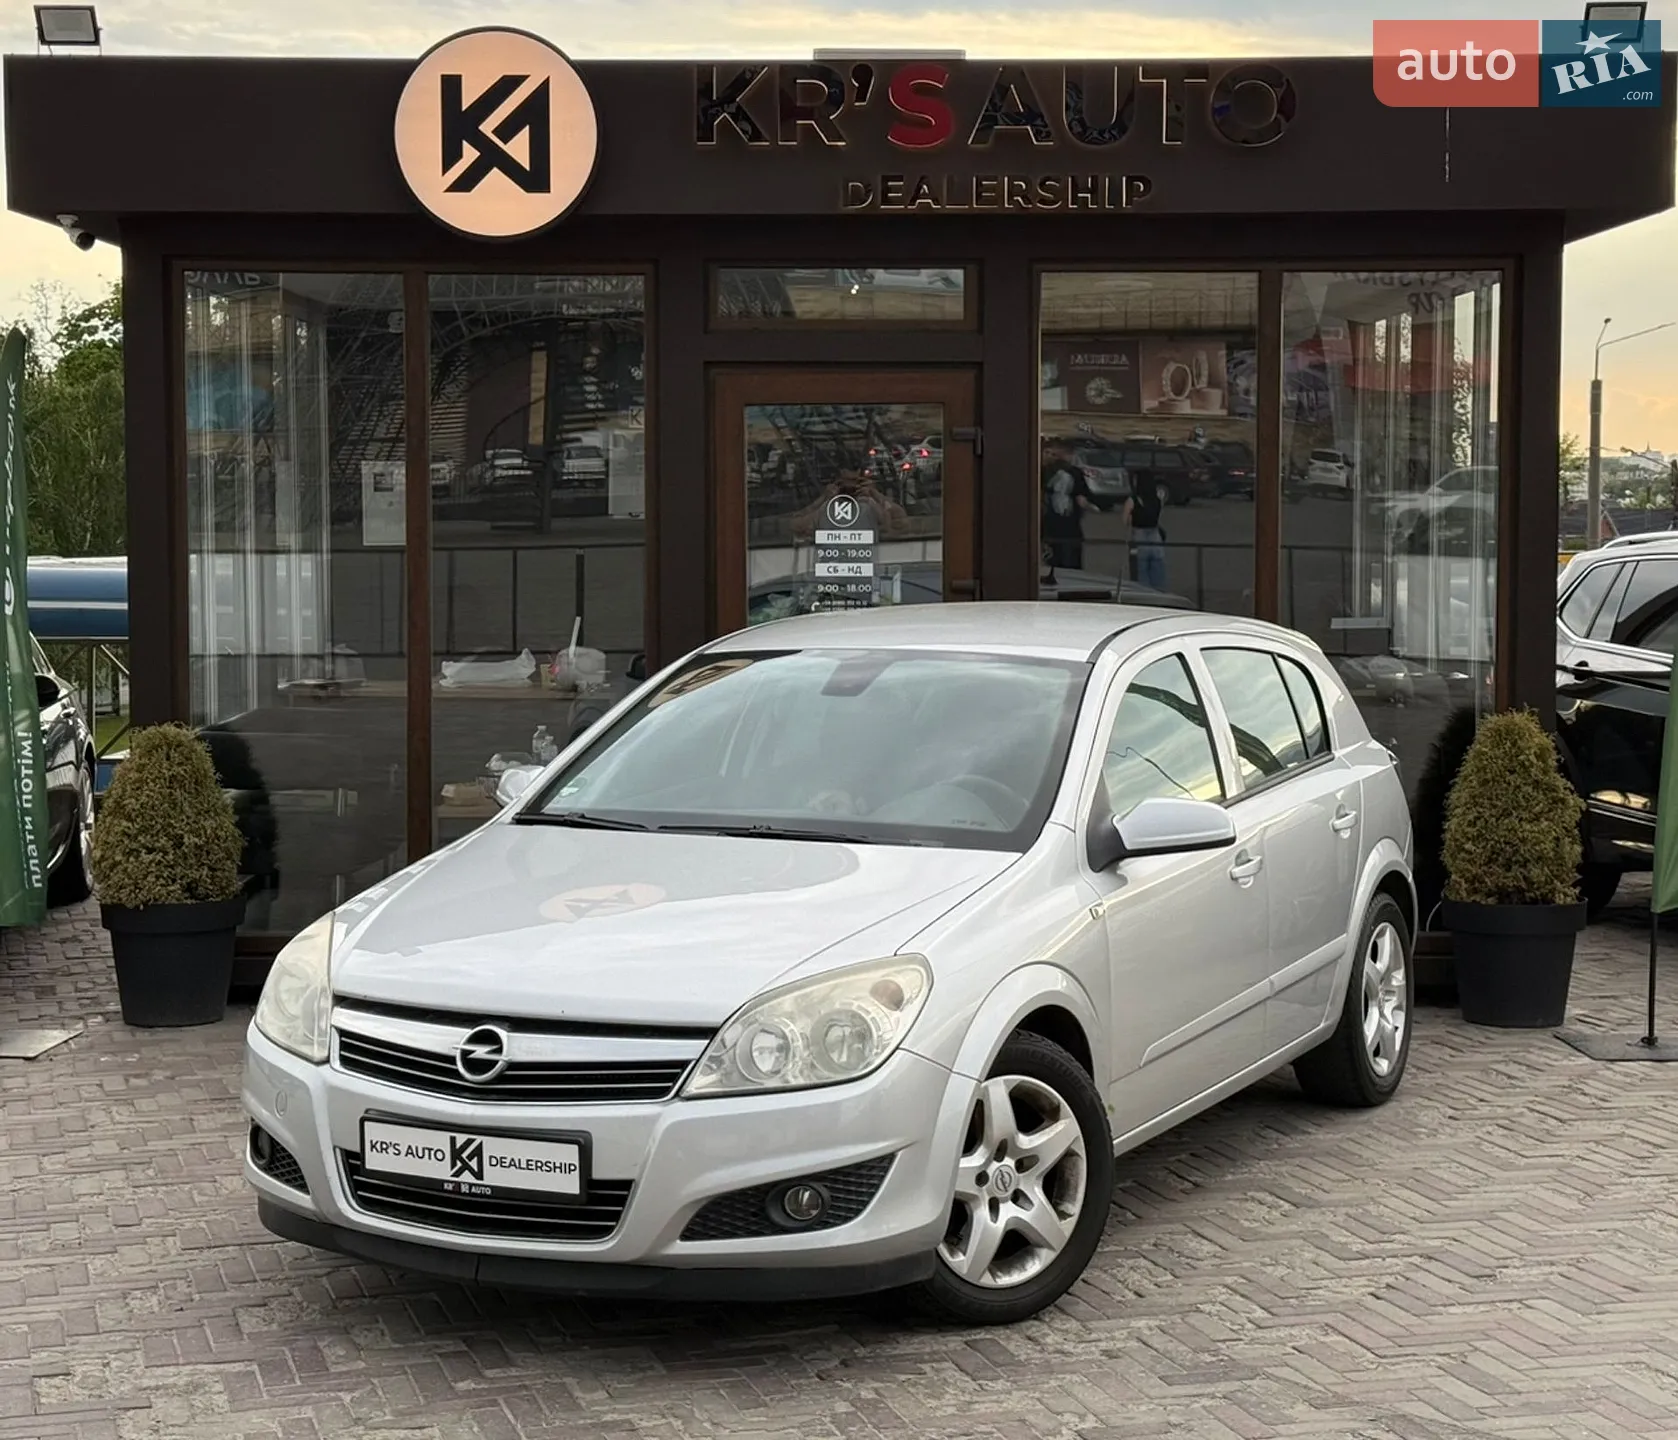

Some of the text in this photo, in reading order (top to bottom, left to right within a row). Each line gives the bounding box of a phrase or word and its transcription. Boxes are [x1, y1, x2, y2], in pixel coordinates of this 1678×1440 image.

[696, 63, 1297, 148] KR'S AUTO
[843, 174, 1152, 210] DEALERSHIP
[827, 533, 841, 541] ПН
[850, 533, 862, 541] ПТ
[827, 565, 839, 574] СБ
[848, 565, 862, 575] НД
[17, 730, 34, 808] потім!
[23, 815, 43, 888] плати
[369, 1140, 402, 1157] KR'S
[404, 1145, 446, 1162] AUTO
[488, 1155, 578, 1175] DEALERSHIP
[470, 1185, 492, 1195] AUTO
